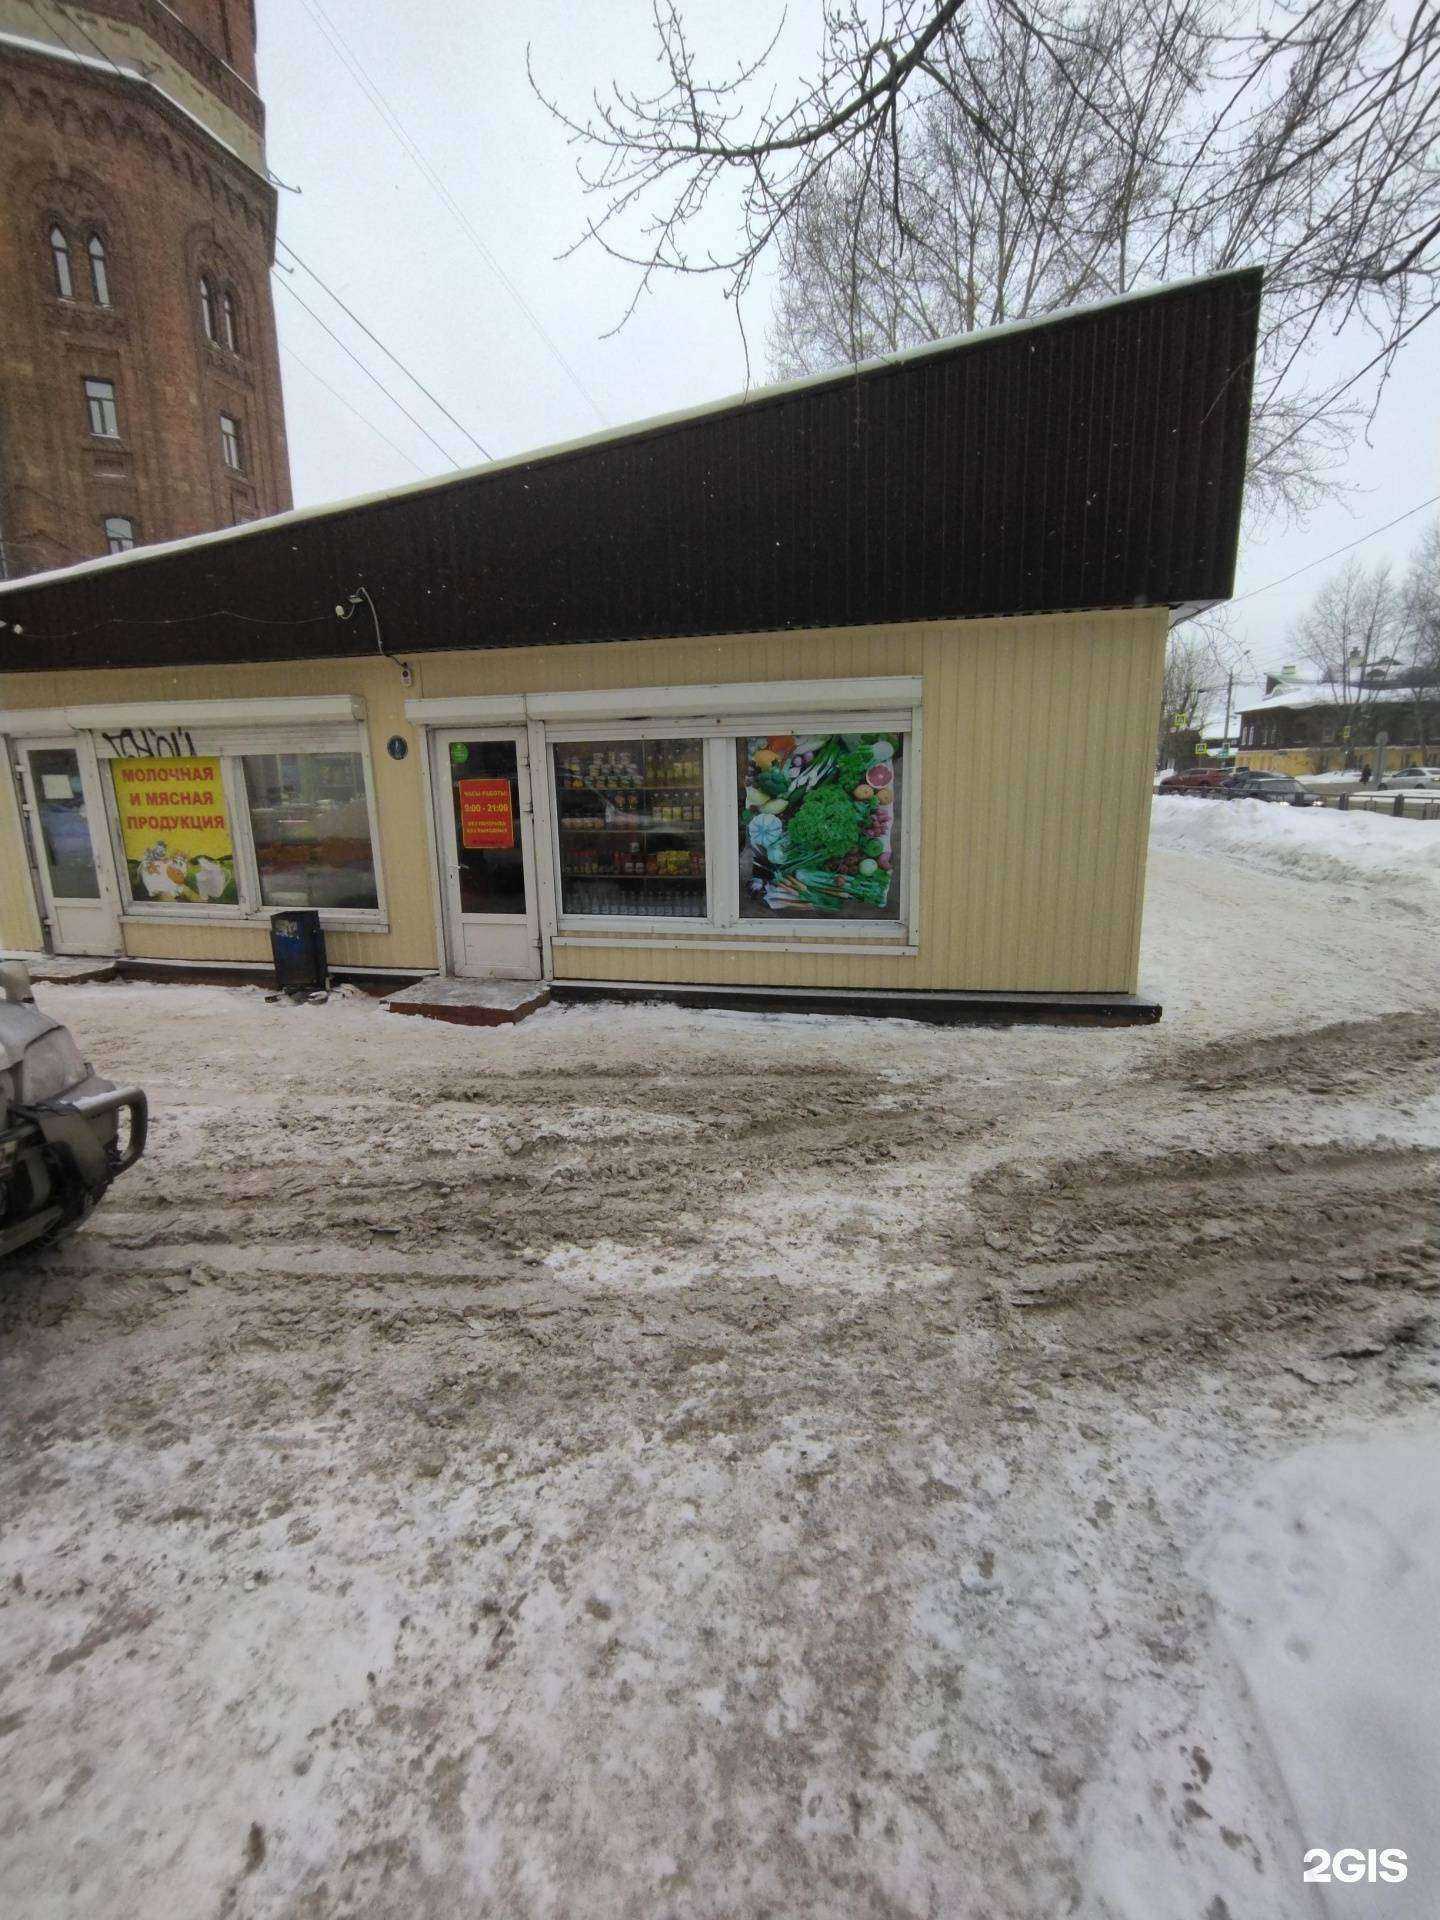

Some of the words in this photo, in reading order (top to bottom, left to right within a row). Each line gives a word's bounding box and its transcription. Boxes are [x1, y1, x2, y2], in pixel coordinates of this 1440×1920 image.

[121, 766, 214, 783] МОЛОЧНАЯ
[129, 792, 141, 806] И
[145, 791, 214, 806] МЯСНАЯ
[126, 814, 225, 832] ПРОДУКЦИЯ
